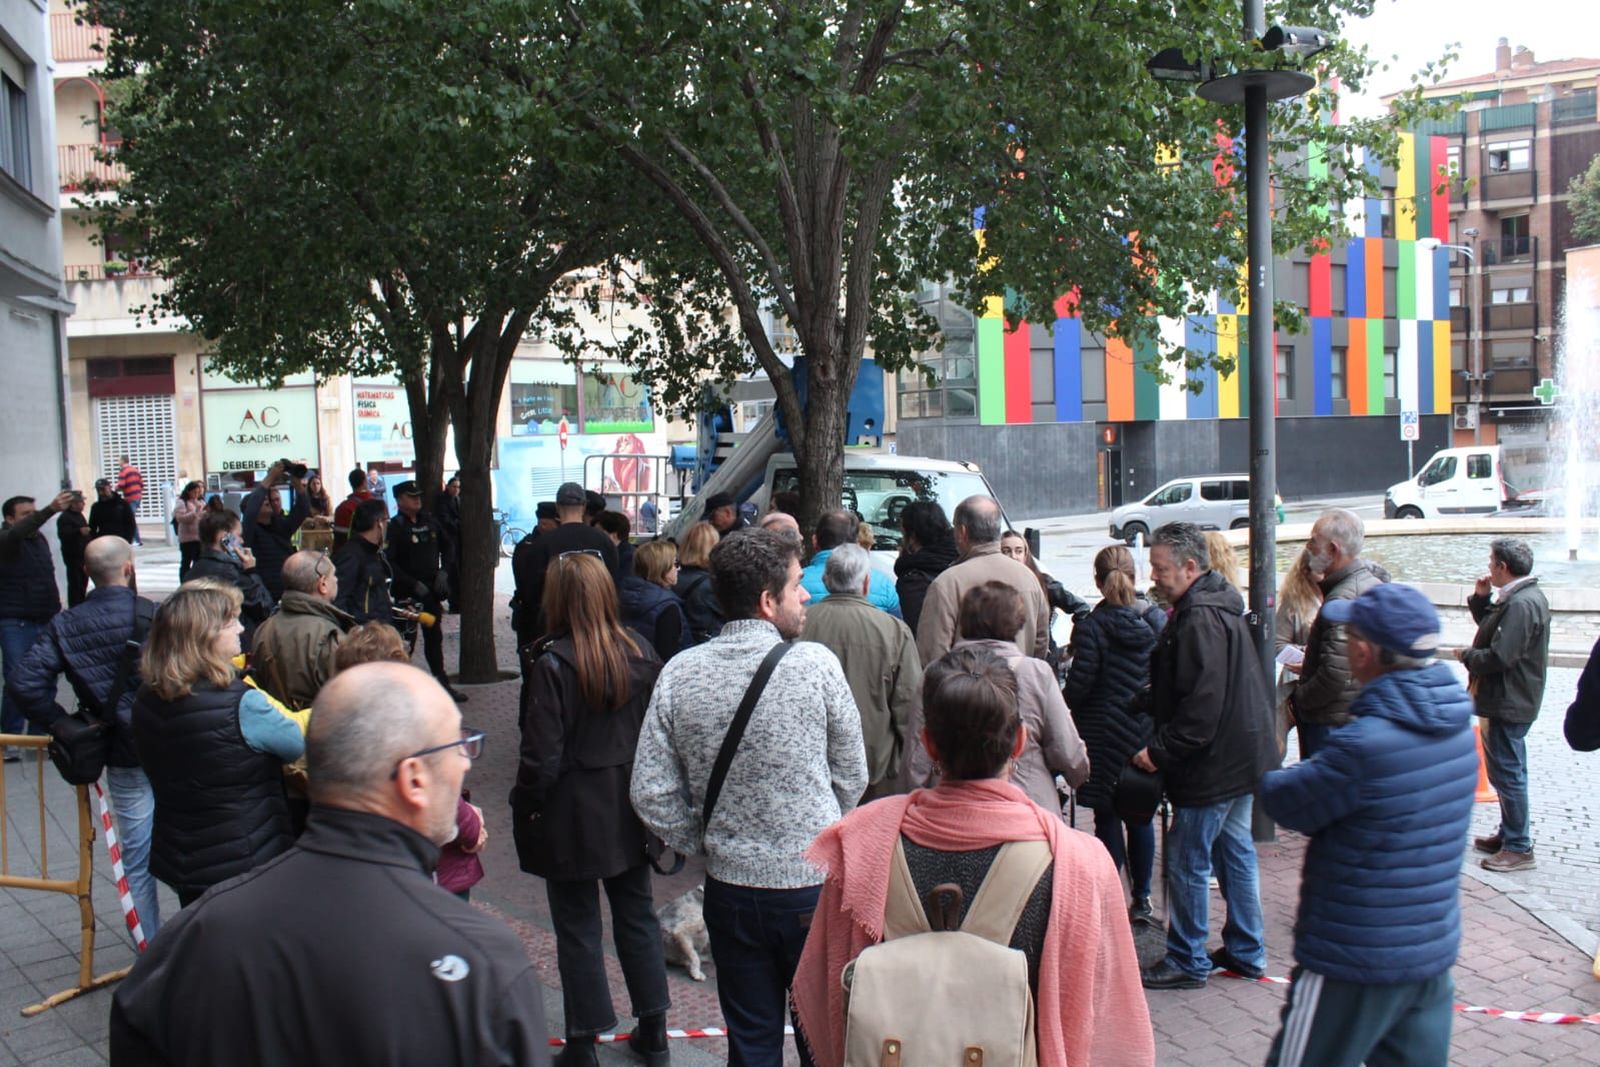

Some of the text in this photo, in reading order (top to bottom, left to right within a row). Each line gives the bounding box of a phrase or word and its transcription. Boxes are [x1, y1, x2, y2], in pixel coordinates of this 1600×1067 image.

[240, 406, 280, 430] AC
[1104, 428, 1112, 442] 1
[222, 460, 267, 470] DEBERES
